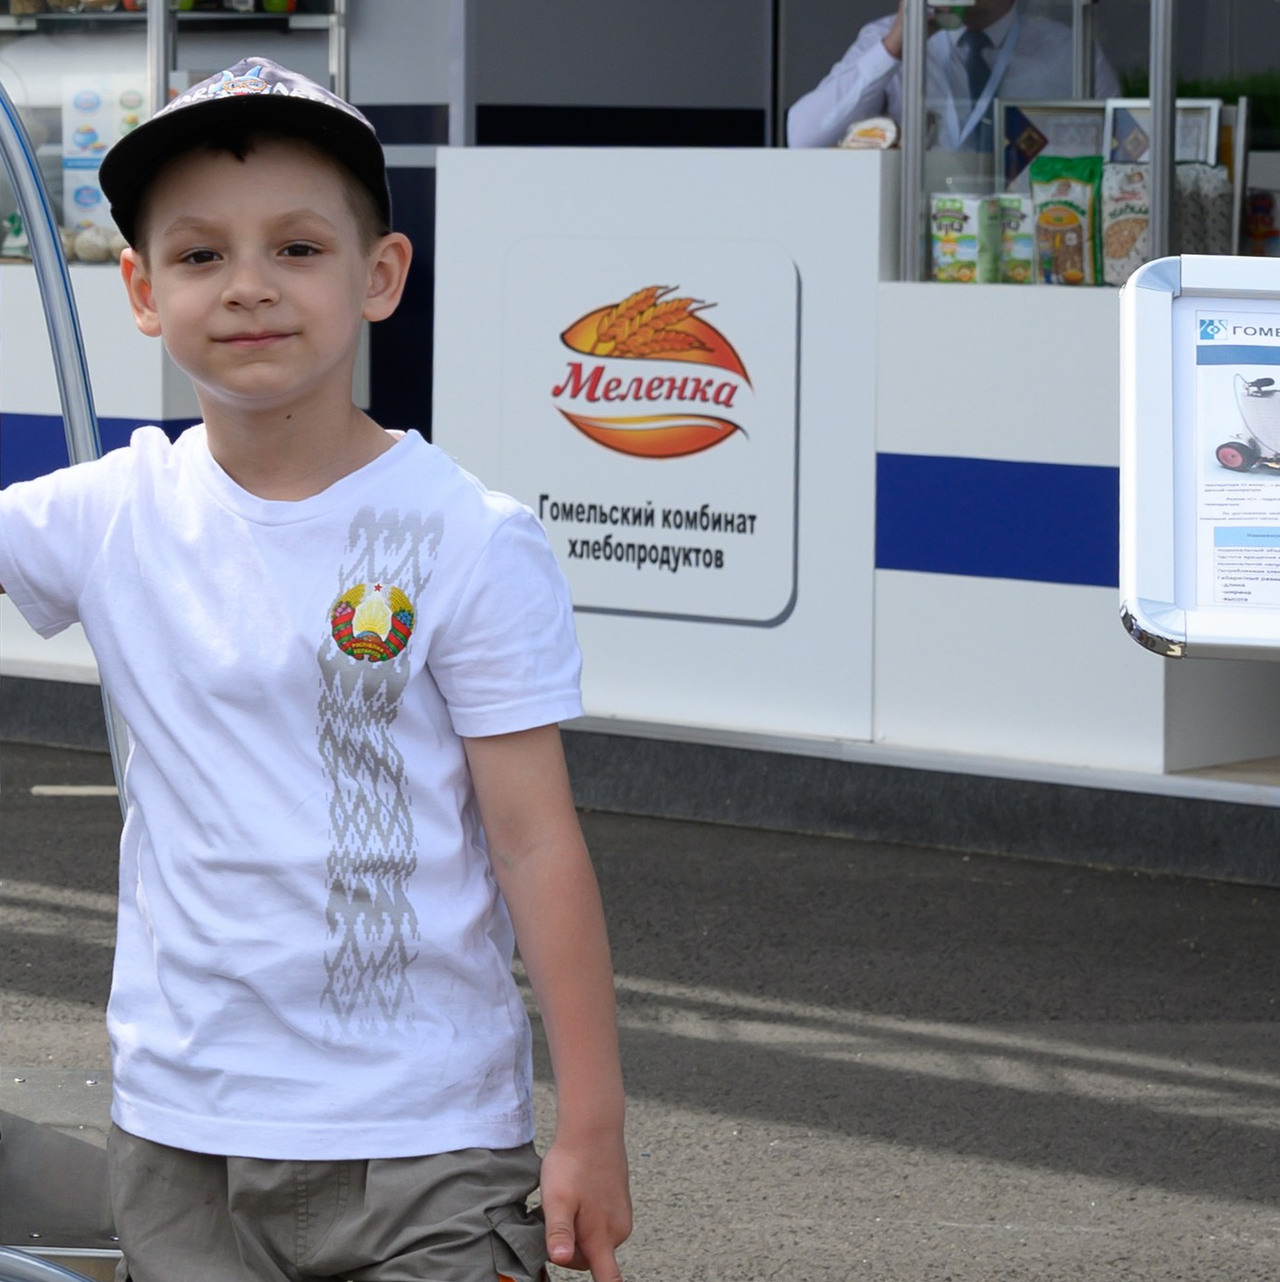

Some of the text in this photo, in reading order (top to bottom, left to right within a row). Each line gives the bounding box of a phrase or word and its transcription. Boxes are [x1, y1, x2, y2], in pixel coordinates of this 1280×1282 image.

[551, 362, 738, 409] Меленка
[538, 494, 757, 535] Гомельский комбинат
[568, 534, 725, 574] хлебопродуктов
